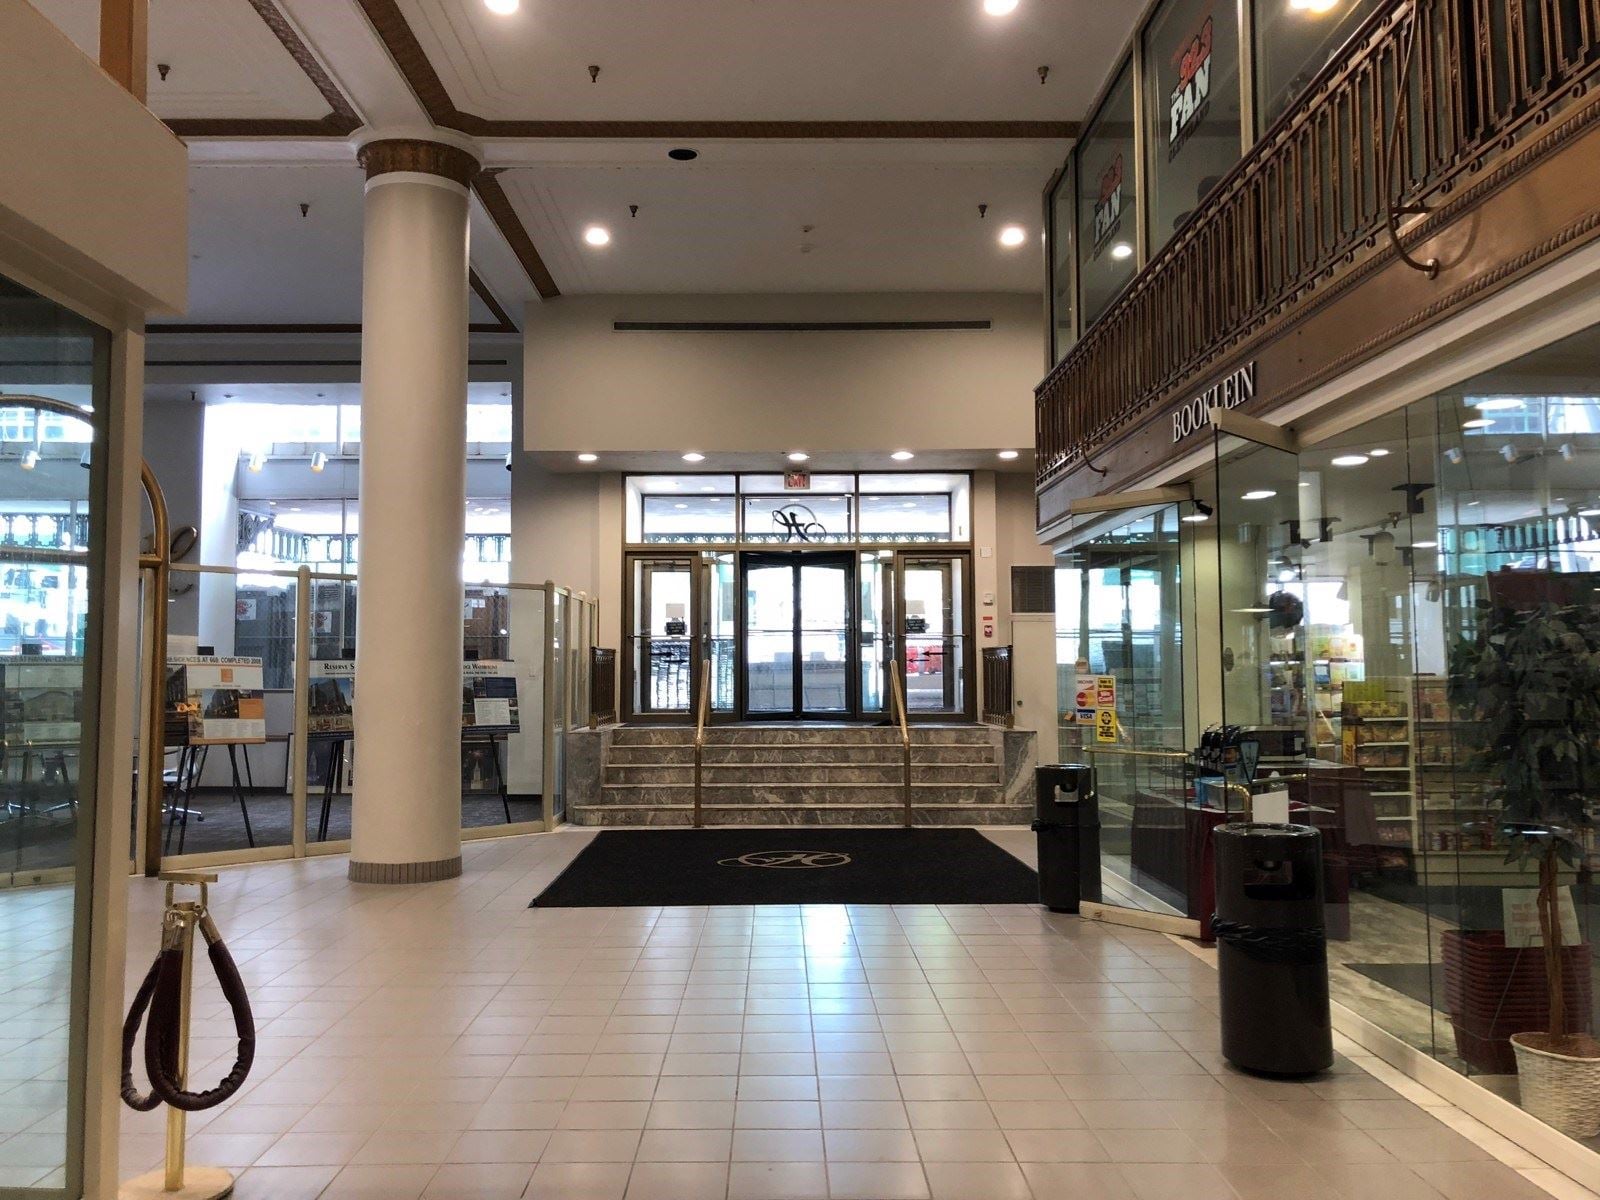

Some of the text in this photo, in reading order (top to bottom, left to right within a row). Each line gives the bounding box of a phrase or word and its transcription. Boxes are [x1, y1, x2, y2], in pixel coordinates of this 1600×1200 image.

[1169, 53, 1212, 145] FAN
[1095, 184, 1122, 247] FAN
[787, 473, 807, 488] EXIT
[220, 656, 251, 664] COMPLETED
